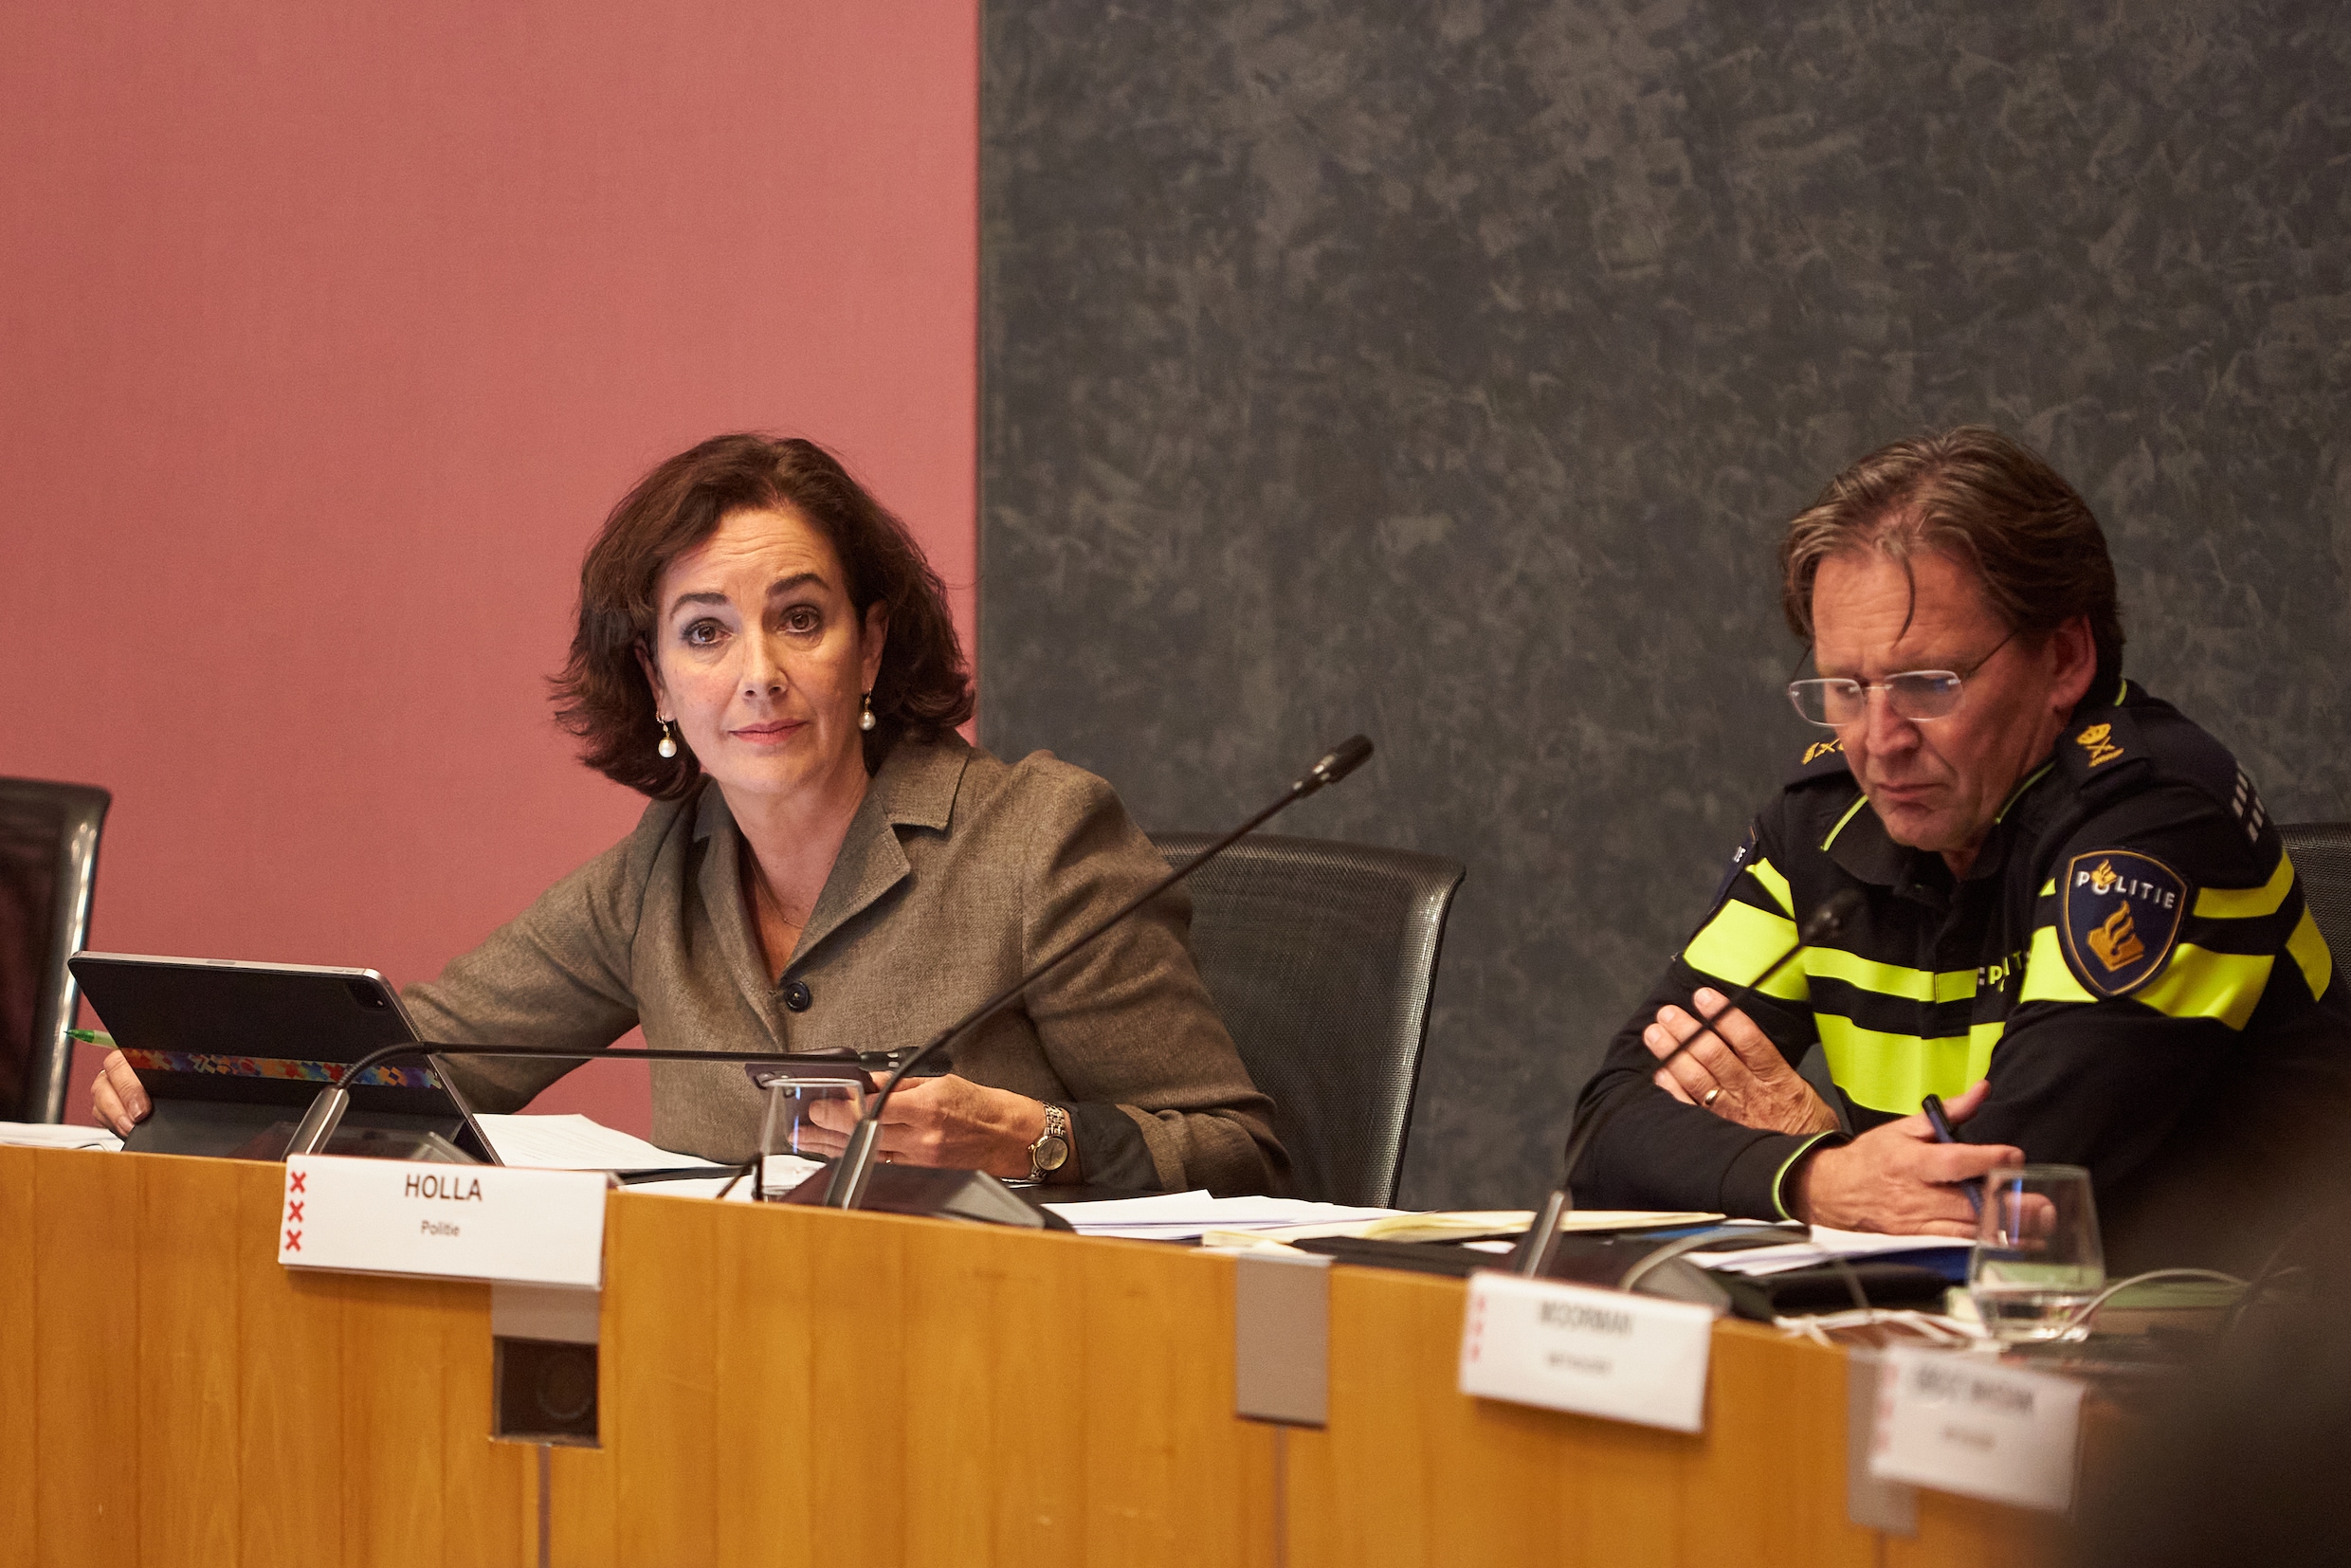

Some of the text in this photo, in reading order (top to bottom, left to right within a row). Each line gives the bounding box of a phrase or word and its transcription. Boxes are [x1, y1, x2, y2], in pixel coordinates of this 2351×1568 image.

[2076, 870, 2176, 909] POLITIE
[405, 1174, 483, 1202] HOLLA
[421, 1220, 461, 1237] Politie
